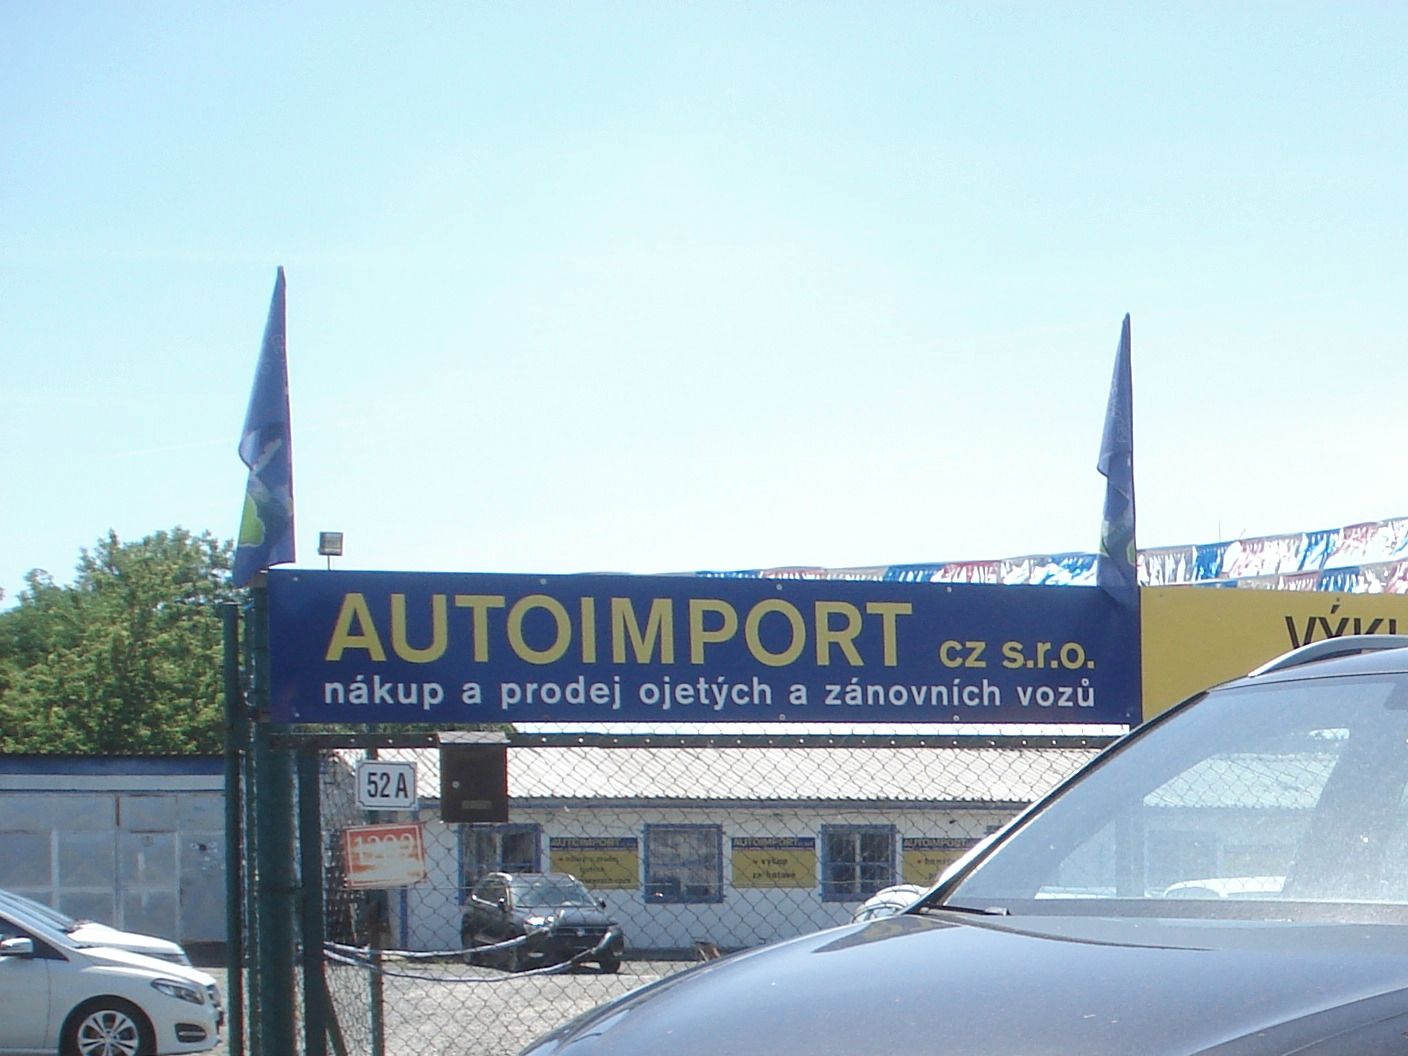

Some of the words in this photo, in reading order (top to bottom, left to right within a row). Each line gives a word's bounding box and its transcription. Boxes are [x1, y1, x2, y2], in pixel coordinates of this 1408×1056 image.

[325, 592, 912, 668] AUTOIMPORT
[1001, 641, 1096, 670] s.r.o.
[324, 675, 445, 711] nákup
[462, 682, 482, 705] a
[500, 675, 621, 710] prodej
[638, 675, 772, 711] ojetých
[789, 683, 808, 706] a
[824, 677, 1001, 707] zánovních
[1016, 678, 1095, 708] vozů
[367, 772, 391, 798] 52
[395, 772, 409, 798] A
